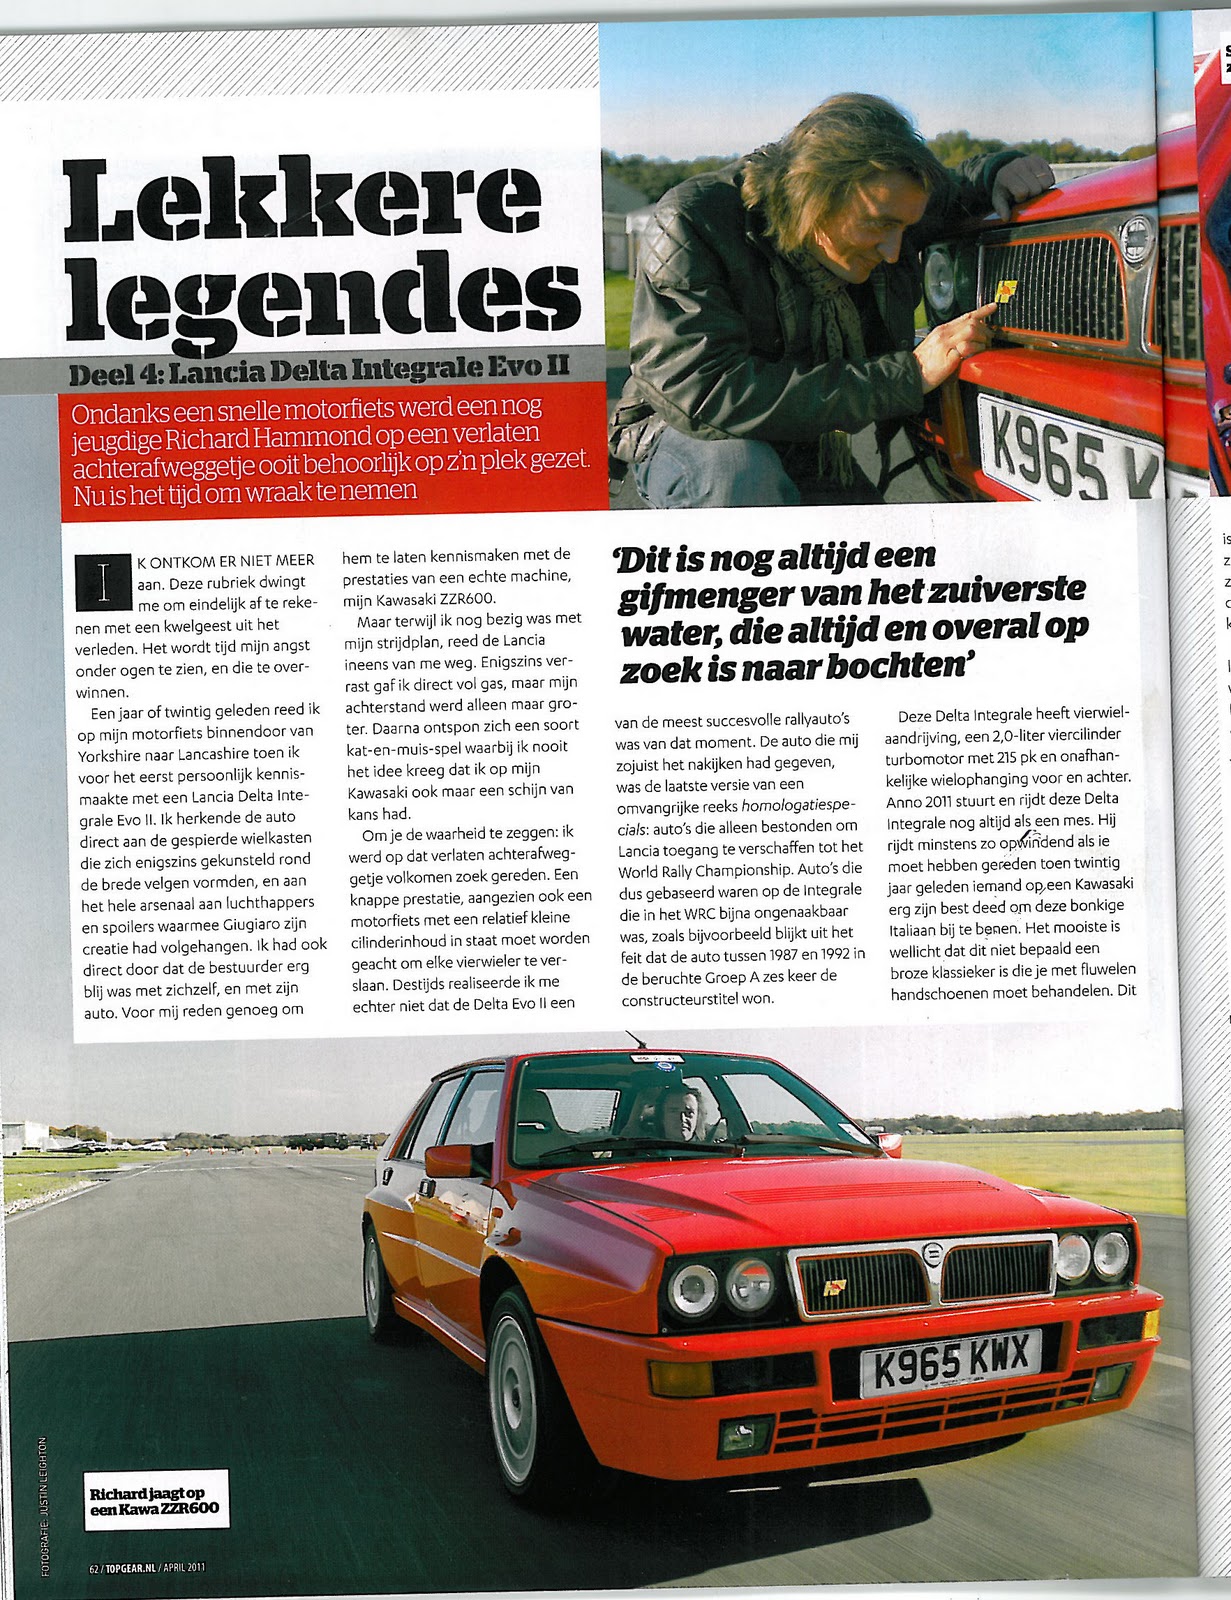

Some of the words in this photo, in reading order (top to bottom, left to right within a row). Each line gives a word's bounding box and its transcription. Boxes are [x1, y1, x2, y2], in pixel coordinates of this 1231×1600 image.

[63, 154, 542, 243] Lekkere
[65, 249, 582, 359] legendes
[70, 363, 136, 387] Deel
[139, 363, 165, 385] 4:
[169, 359, 266, 385] Lancia
[271, 358, 348, 383] Delta
[352, 356, 484, 384] Integrale
[487, 354, 543, 378] Evo
[546, 353, 571, 377] II
[72, 403, 170, 424] Ondanks
[174, 406, 214, 422] een
[218, 401, 280, 421] snelle
[285, 398, 394, 419] motorfiets
[398, 396, 453, 416] werd
[458, 400, 497, 415] een
[501, 399, 542, 418] nog
[72, 431, 161, 456] jeugdige
[166, 428, 250, 449] Richard
[254, 425, 372, 447] Hammond
[376, 429, 404, 449] op
[408, 428, 448, 444] een
[452, 422, 539, 442] verlaten
[991, 405, 1108, 500] K965
[73, 456, 255, 481] achterafweggetje
[259, 455, 300, 474] ooit
[303, 452, 411, 476] behoorlijk
[415, 456, 443, 475] op
[480, 449, 527, 474] plek
[531, 449, 590, 473] gezet.
[74, 486, 106, 506] Nu
[110, 490, 126, 505] is
[130, 485, 164, 504] het
[169, 484, 201, 508] tijd
[206, 488, 241, 503] om
[246, 482, 312, 502] wraak
[316, 482, 336, 500] te
[340, 484, 417, 500] nemen
[138, 558, 146, 569] K
[150, 556, 215, 569] ONTKOM
[220, 556, 236, 567] ER
[241, 555, 272, 566] NIET
[276, 554, 314, 566] MEER
[676, 544, 705, 572] is
[710, 550, 774, 577] nog
[778, 541, 870, 575] altijd
[874, 546, 936, 568] een
[344, 595, 372, 610] mijn
[377, 592, 436, 606] Kawasaki
[440, 592, 496, 605] ZZR600.
[618, 582, 796, 616] gifmenger
[801, 585, 862, 606] van
[868, 578, 925, 605] het
[928, 575, 1086, 603] zuiverste
[621, 621, 722, 649] water,
[730, 616, 783, 645] die
[788, 615, 880, 648] altijd
[885, 620, 927, 641] en
[933, 612, 1041, 640] overal
[1045, 617, 1089, 643] op
[620, 656, 703, 684] zoek
[708, 654, 737, 682] is
[742, 659, 823, 681] naar
[899, 711, 931, 722] Deze
[936, 709, 969, 722] Delta
[974, 707, 1032, 723] Integrale
[1036, 706, 1070, 719] heeft
[1074, 705, 1129, 719] vierwiel-
[78, 749, 140, 762] Yorkshire
[146, 752, 174, 761] naar
[179, 747, 249, 760] Lancashire
[254, 749, 284, 759] toen
[289, 745, 299, 758] ik
[347, 741, 461, 757] kat-en-muis-spel
[465, 741, 512, 756] waarbij
[518, 740, 528, 753] ik
[533, 741, 568, 752] nooit
[617, 761, 659, 775] zojuist
[663, 758, 684, 771] het
[689, 757, 742, 773] nakijken
[747, 756, 770, 769] had
[775, 758, 834, 771] gegeven,
[887, 774, 927, 790] kelijke
[931, 772, 1028, 788] wielophanging
[1032, 775, 1063, 784] voor
[1067, 774, 1082, 783] en
[1087, 770, 1131, 783] achter.
[80, 835, 119, 848] direct
[123, 838, 146, 847] aan
[151, 834, 167, 847] de
[171, 832, 237, 849] gespierde
[241, 831, 311, 844] wielkasten
[350, 874, 383, 888] getje
[386, 871, 452, 884] volkomen
[456, 869, 488, 882] zoek
[491, 868, 550, 884] gereden.
[555, 868, 578, 880] Een
[618, 865, 657, 878] World
[663, 865, 692, 880] Rally
[696, 863, 794, 879] Championship.
[842, 861, 862, 874] die
[82, 925, 98, 934] en
[103, 920, 154, 936] spoilers
[158, 922, 219, 932] waarmee
[223, 918, 280, 933] Giugiaro
[284, 917, 306, 932] zijn
[351, 934, 446, 949] cilinderinhoud
[451, 938, 462, 946] in
[466, 935, 497, 946] staat
[502, 935, 536, 945] moet
[540, 931, 589, 944] worden
[622, 951, 642, 964] feit
[646, 951, 667, 963] dat
[671, 950, 687, 963] de
[691, 952, 720, 962] auto
[724, 952, 766, 962] tussen
[770, 949, 798, 961] 1987
[802, 951, 817, 960] en
[821, 948, 849, 959] 1992
[854, 947, 865, 959] in
[892, 987, 988, 1001] handschoenen
[993, 988, 1027, 998] moet
[1032, 984, 1114, 998] behandelen.
[1118, 984, 1137, 996] Dit
[875, 1343, 961, 1389] K965
[970, 1334, 1029, 1375] KWX
[38, 1437, 48, 1483] LEIGHTON
[40, 1485, 49, 1516] JUSTIN
[90, 1488, 148, 1500] Richard
[149, 1487, 185, 1502] jaagt
[186, 1489, 205, 1500] op
[91, 1507, 117, 1516] een
[119, 1504, 159, 1515] Kawa
[161, 1502, 219, 1514] ZZR600
[89, 1564, 99, 1574] 62
[106, 1563, 157, 1574] TOPGEAR.NL
[163, 1562, 186, 1573] APRIL
[187, 1562, 205, 1572] 2011
